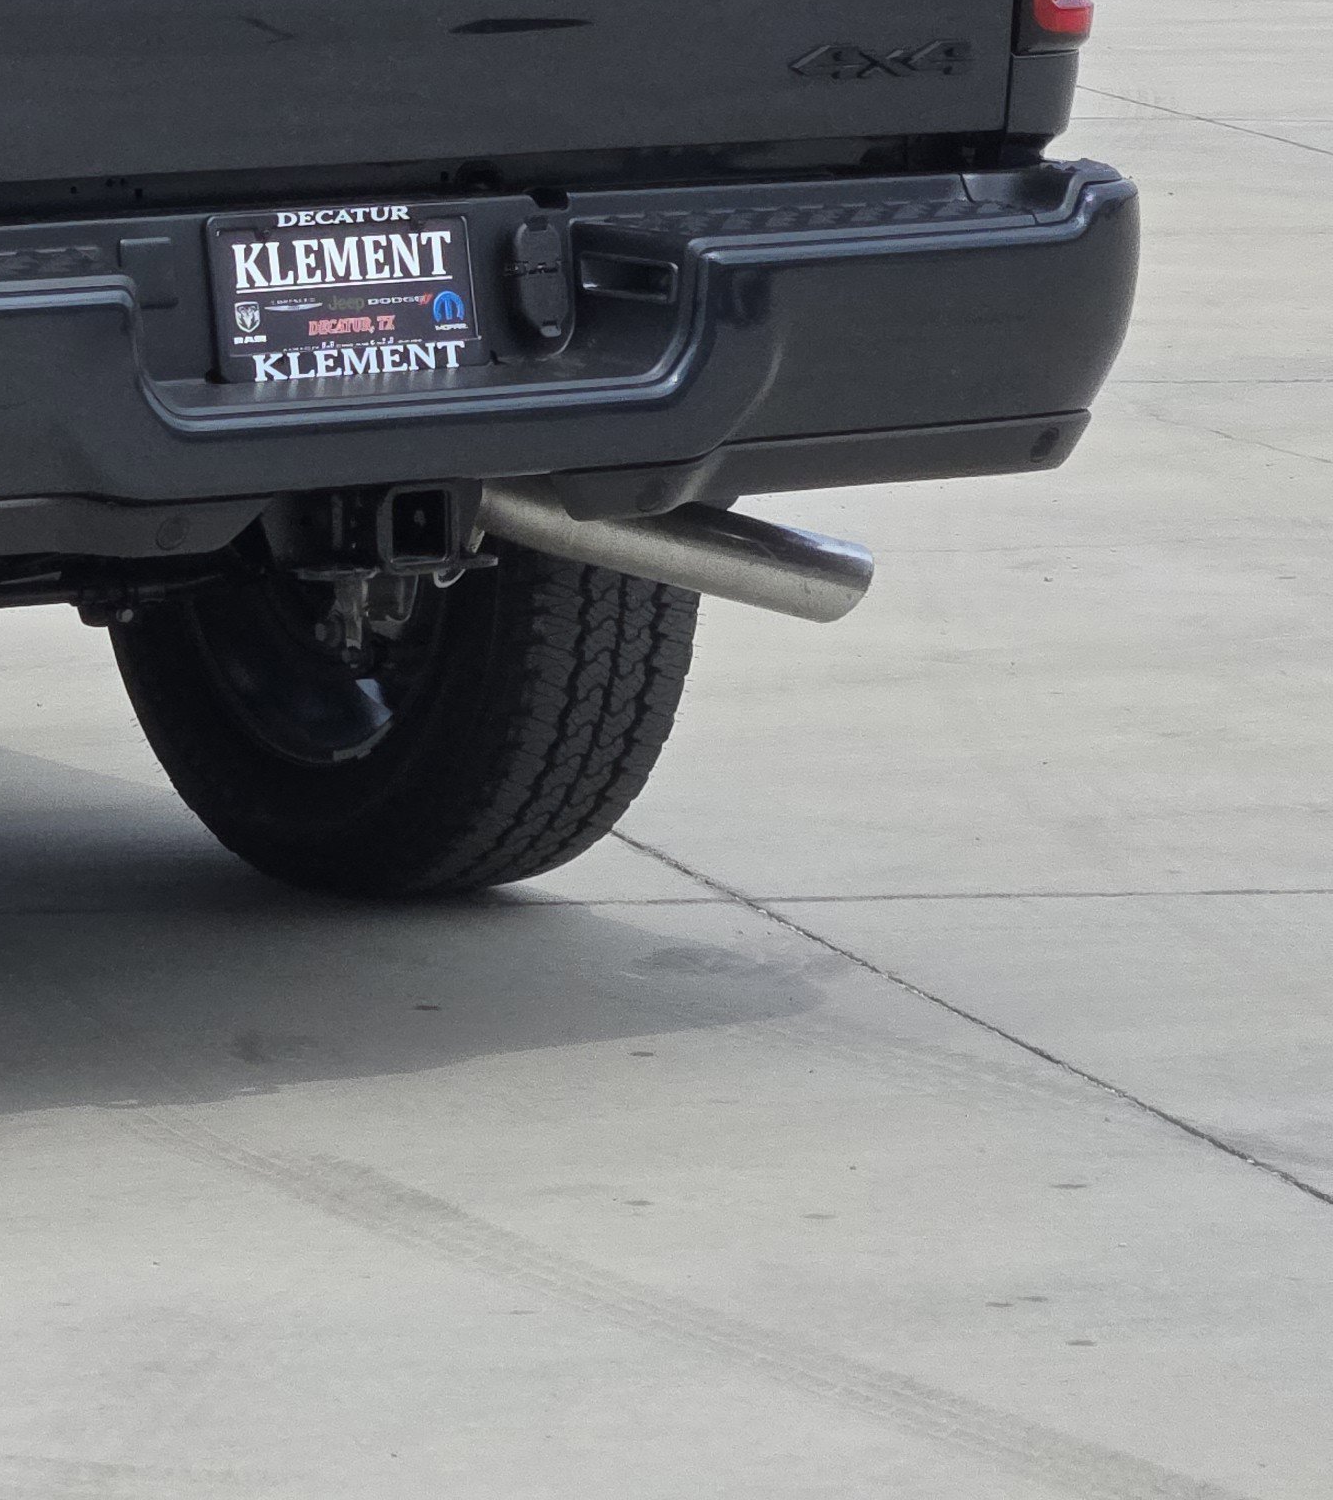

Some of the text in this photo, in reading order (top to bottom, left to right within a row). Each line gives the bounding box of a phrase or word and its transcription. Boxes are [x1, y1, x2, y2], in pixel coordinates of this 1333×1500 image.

[276, 205, 410, 229] DECATUR
[231, 230, 452, 290] KLEMENT
[376, 314, 396, 331] TX
[252, 340, 466, 383] KLEMENT
